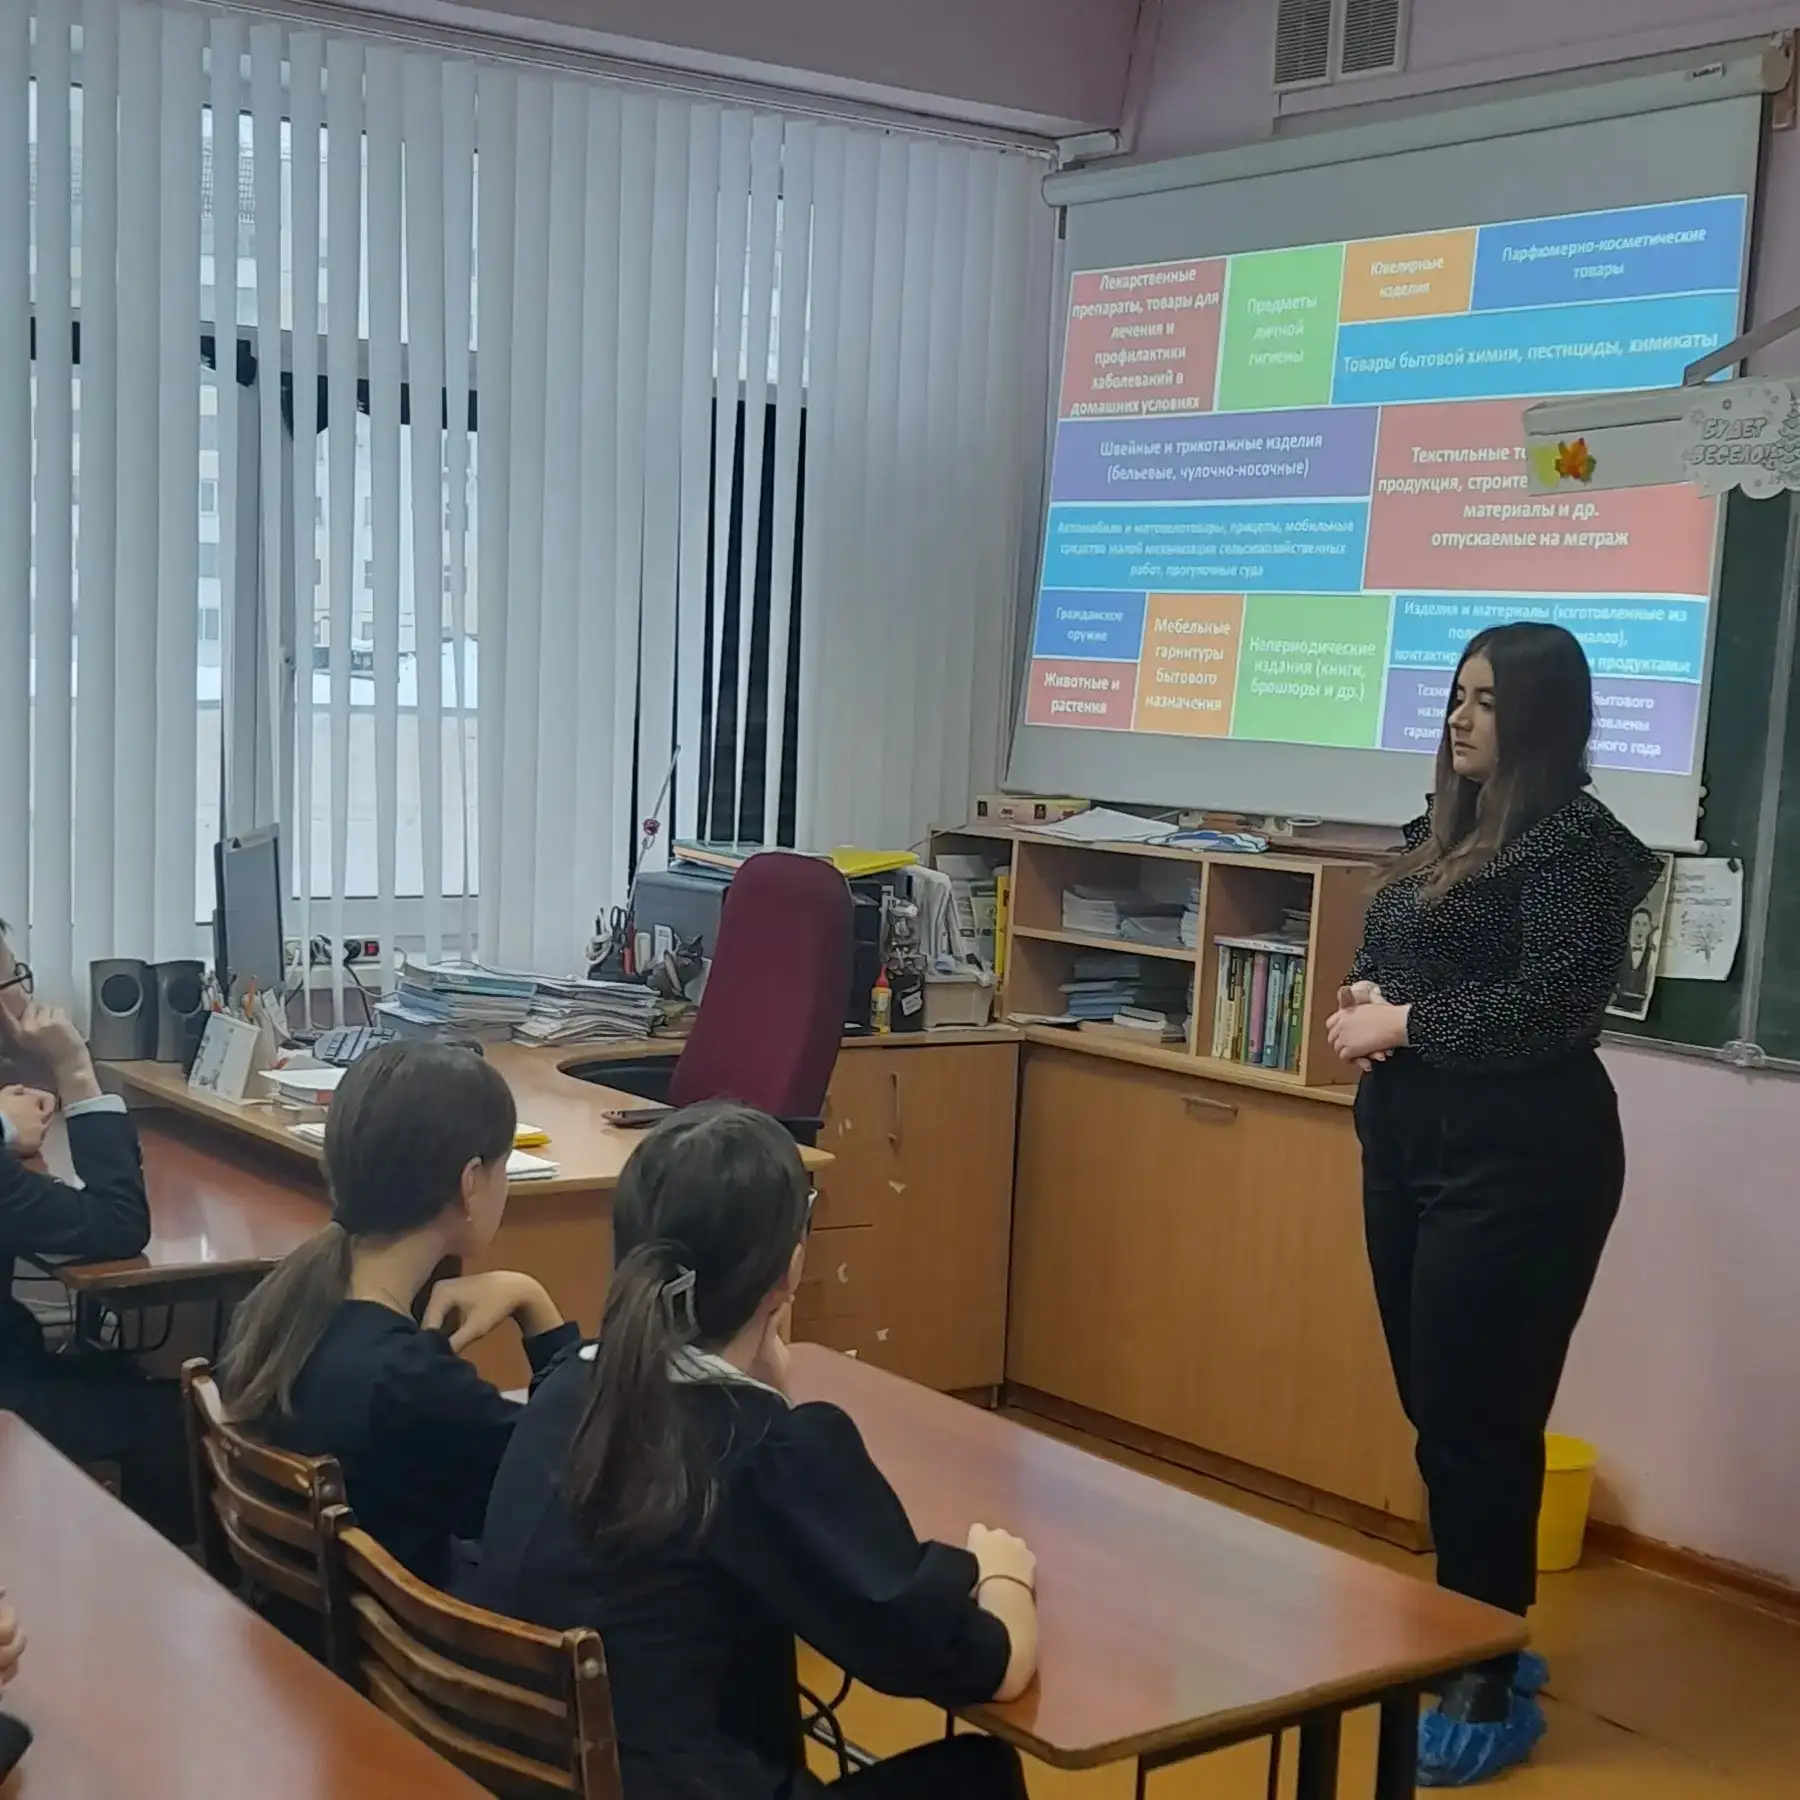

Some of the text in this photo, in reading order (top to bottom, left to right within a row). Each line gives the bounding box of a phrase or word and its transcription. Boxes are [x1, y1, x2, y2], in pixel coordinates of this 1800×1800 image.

[1100, 267, 1196, 291] Лекарственные
[1573, 262, 1624, 279] товары
[1072, 292, 1219, 318] препараты, товары для
[1247, 297, 1316, 315] Предметы
[1111, 322, 1174, 338] лечения и
[1095, 347, 1186, 366] профилактики
[1344, 332, 1718, 373] Товары бытовой химии, пестициды, химикаты
[1091, 370, 1173, 390] заболеваний
[1070, 397, 1199, 417] домашних условиях
[1703, 417, 1768, 440] БУДЕТ
[1100, 434, 1322, 456] Швейные и трикотажные изделия
[1412, 446, 1509, 463] Текстильные
[1107, 458, 1309, 483] (бельевые, чулочно-носочные)
[1378, 475, 1528, 493] продукция, строите
[1463, 502, 1599, 520] материалы и др.
[1431, 531, 1628, 549] отпускаемые на метраж
[1404, 601, 1458, 617] Изделия
[1461, 606, 1470, 616] и
[1471, 604, 1549, 620] материалы
[1154, 618, 1231, 636] Мебельные
[1067, 630, 1107, 644] оружие
[1155, 645, 1224, 663] гарнитуры
[1250, 636, 1376, 657] Непериодические
[1254, 660, 1312, 675] издания
[1044, 672, 1120, 691] Животные и
[1156, 669, 1217, 685] бытового
[1251, 679, 1320, 697] брошюры
[1324, 686, 1334, 696] и
[1051, 699, 1106, 715] растения
[1145, 697, 1222, 711] назначения
